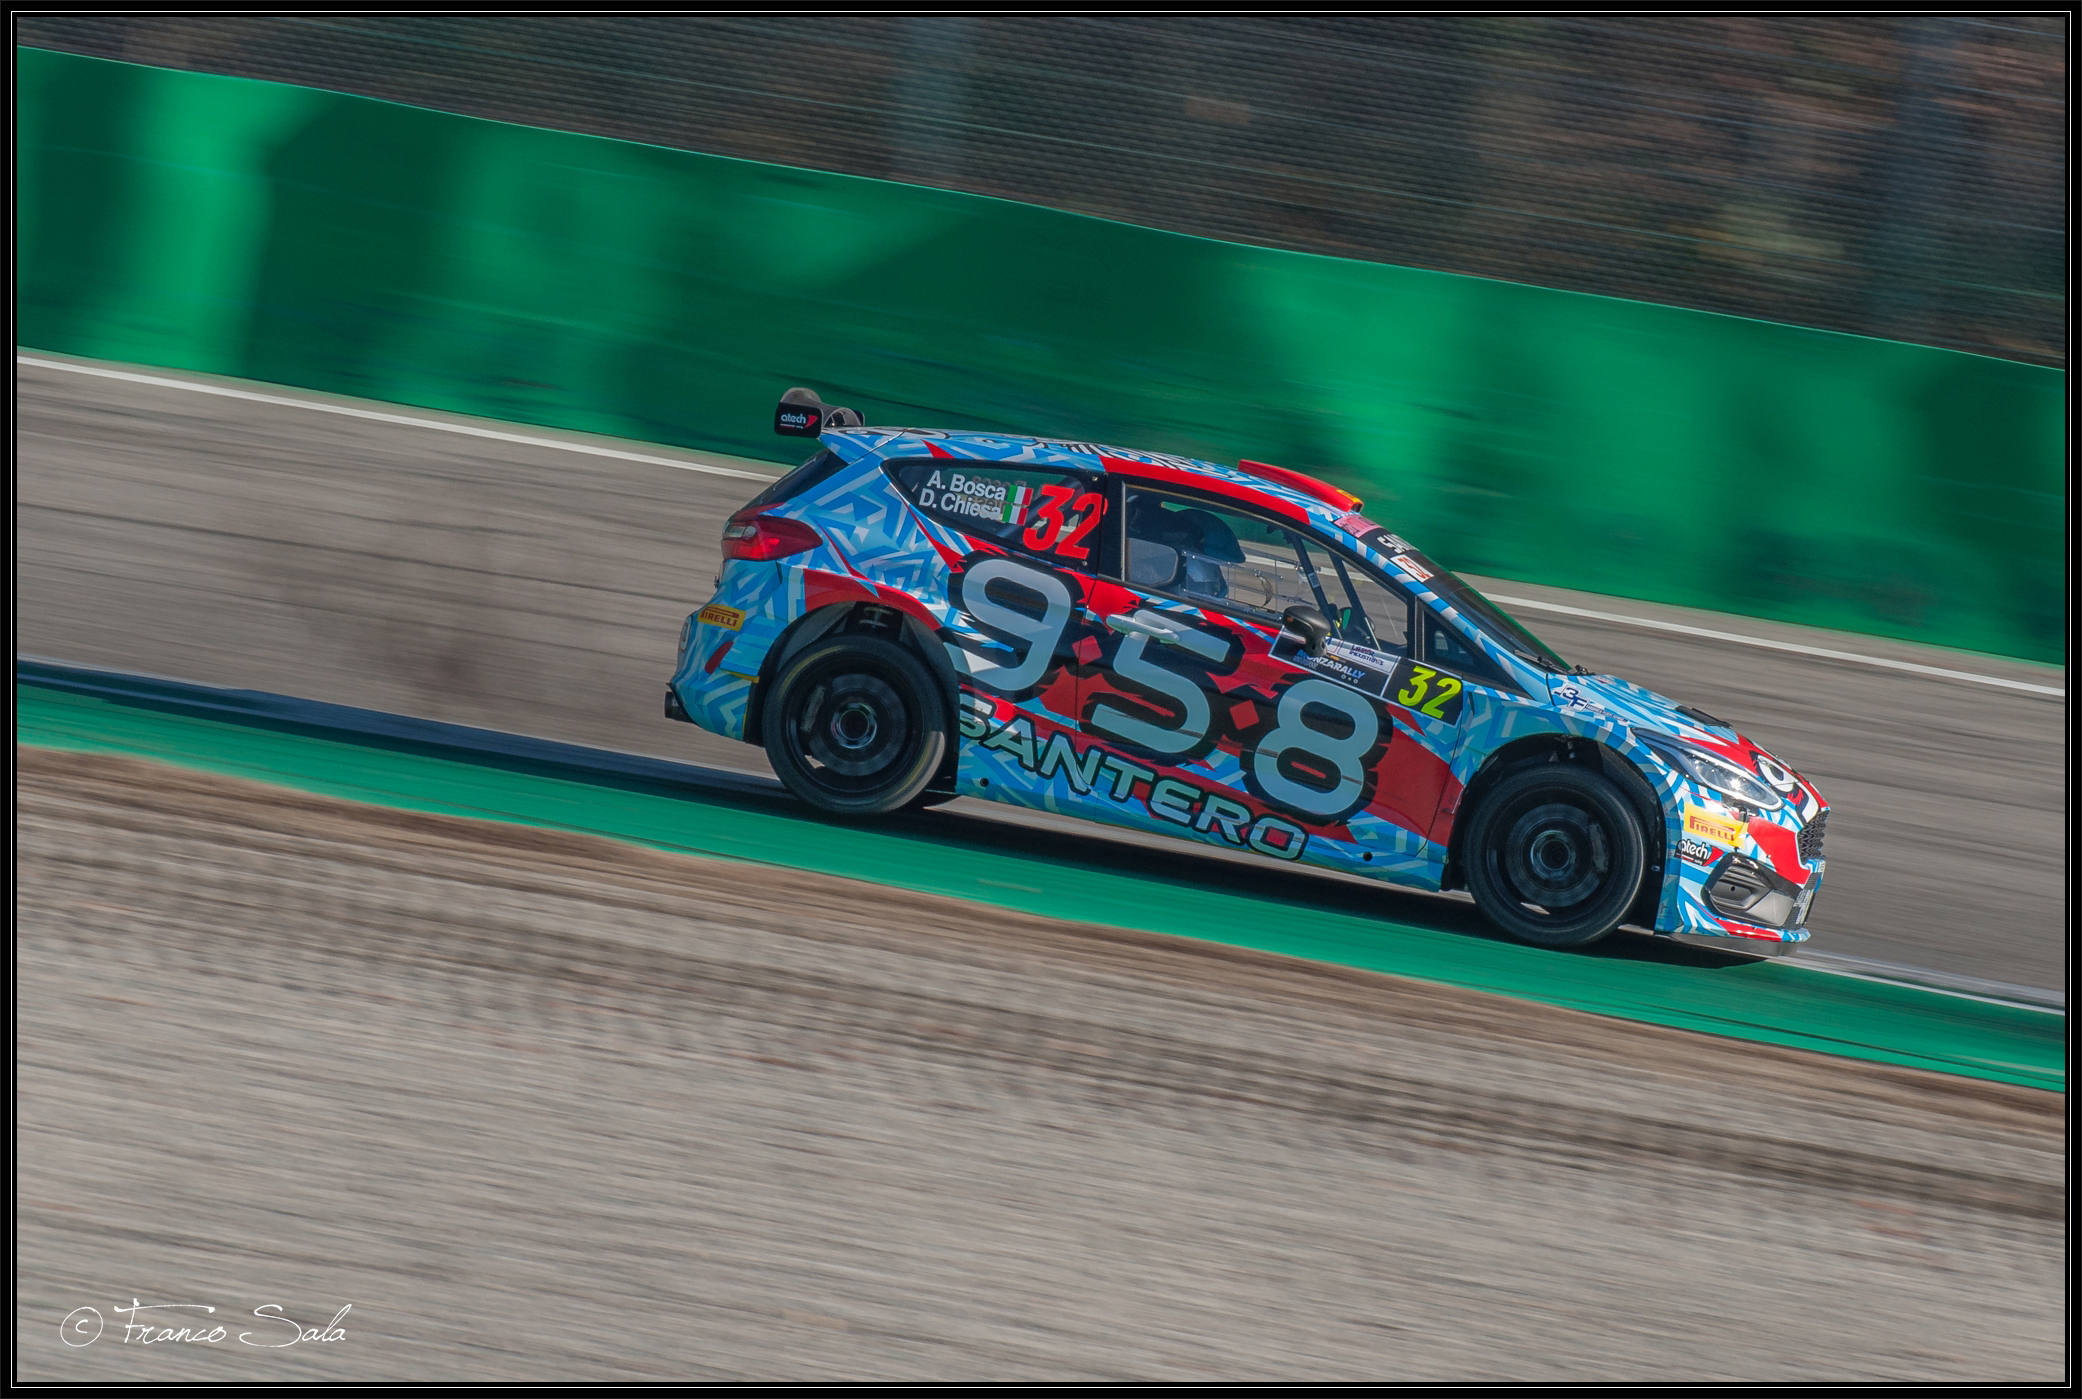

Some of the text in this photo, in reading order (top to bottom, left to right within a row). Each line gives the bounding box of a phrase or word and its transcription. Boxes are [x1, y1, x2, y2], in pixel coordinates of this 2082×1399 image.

[926, 469, 1007, 501] A. Bosca
[919, 488, 1002, 520] D. Chiesa
[1022, 484, 1107, 560] 32
[701, 606, 739, 627] PIRELLI
[1398, 666, 1462, 719] 32
[959, 693, 1308, 860] SANTERO
[1690, 815, 1734, 841] PIRELLI
